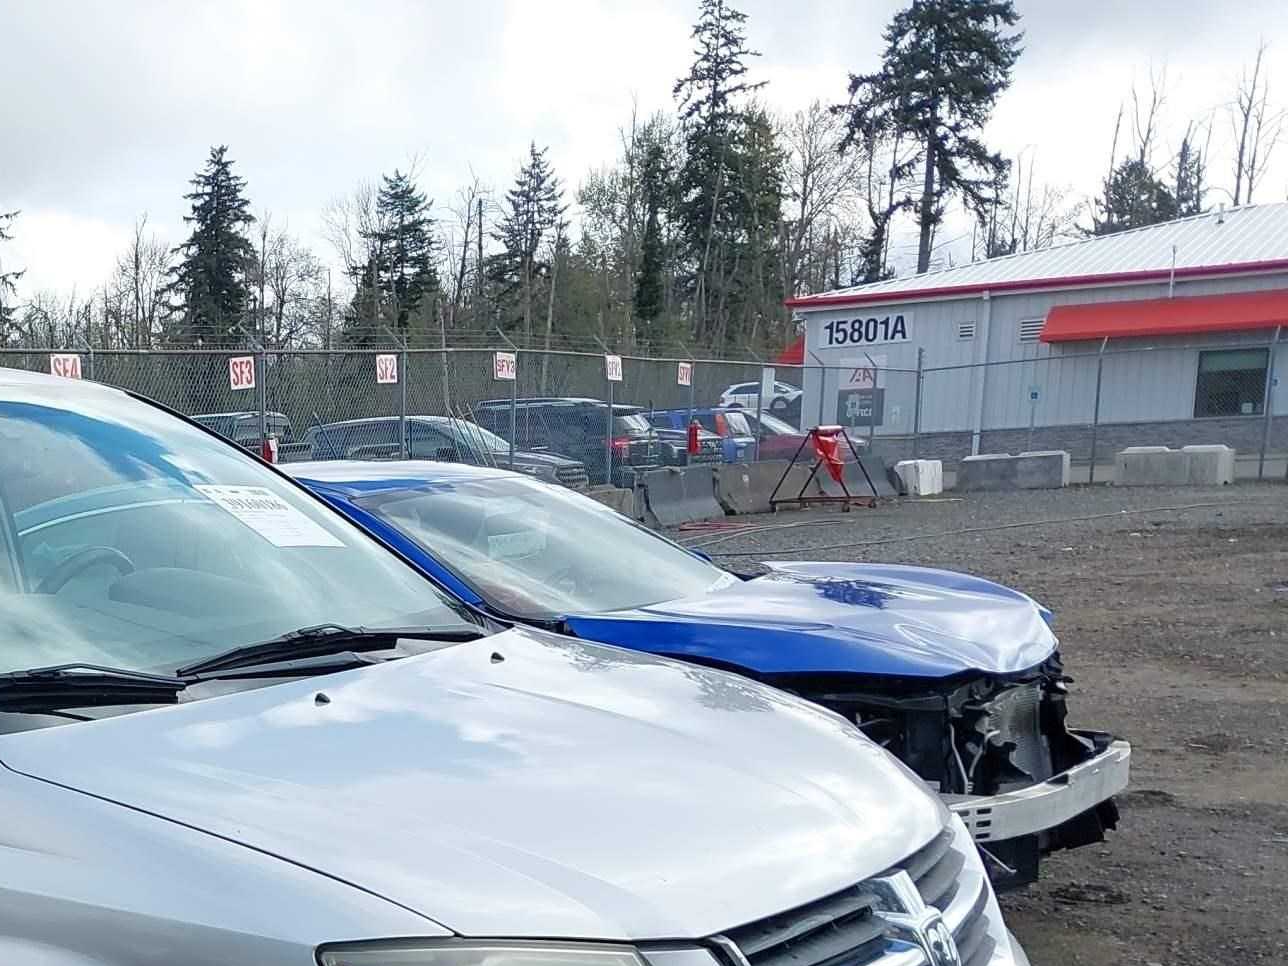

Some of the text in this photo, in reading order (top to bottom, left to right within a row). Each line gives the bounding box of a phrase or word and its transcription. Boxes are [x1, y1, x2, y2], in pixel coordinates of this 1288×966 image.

[824, 315, 907, 345] 15801A
[232, 360, 253, 386] SF3
[378, 358, 396, 380] SF2
